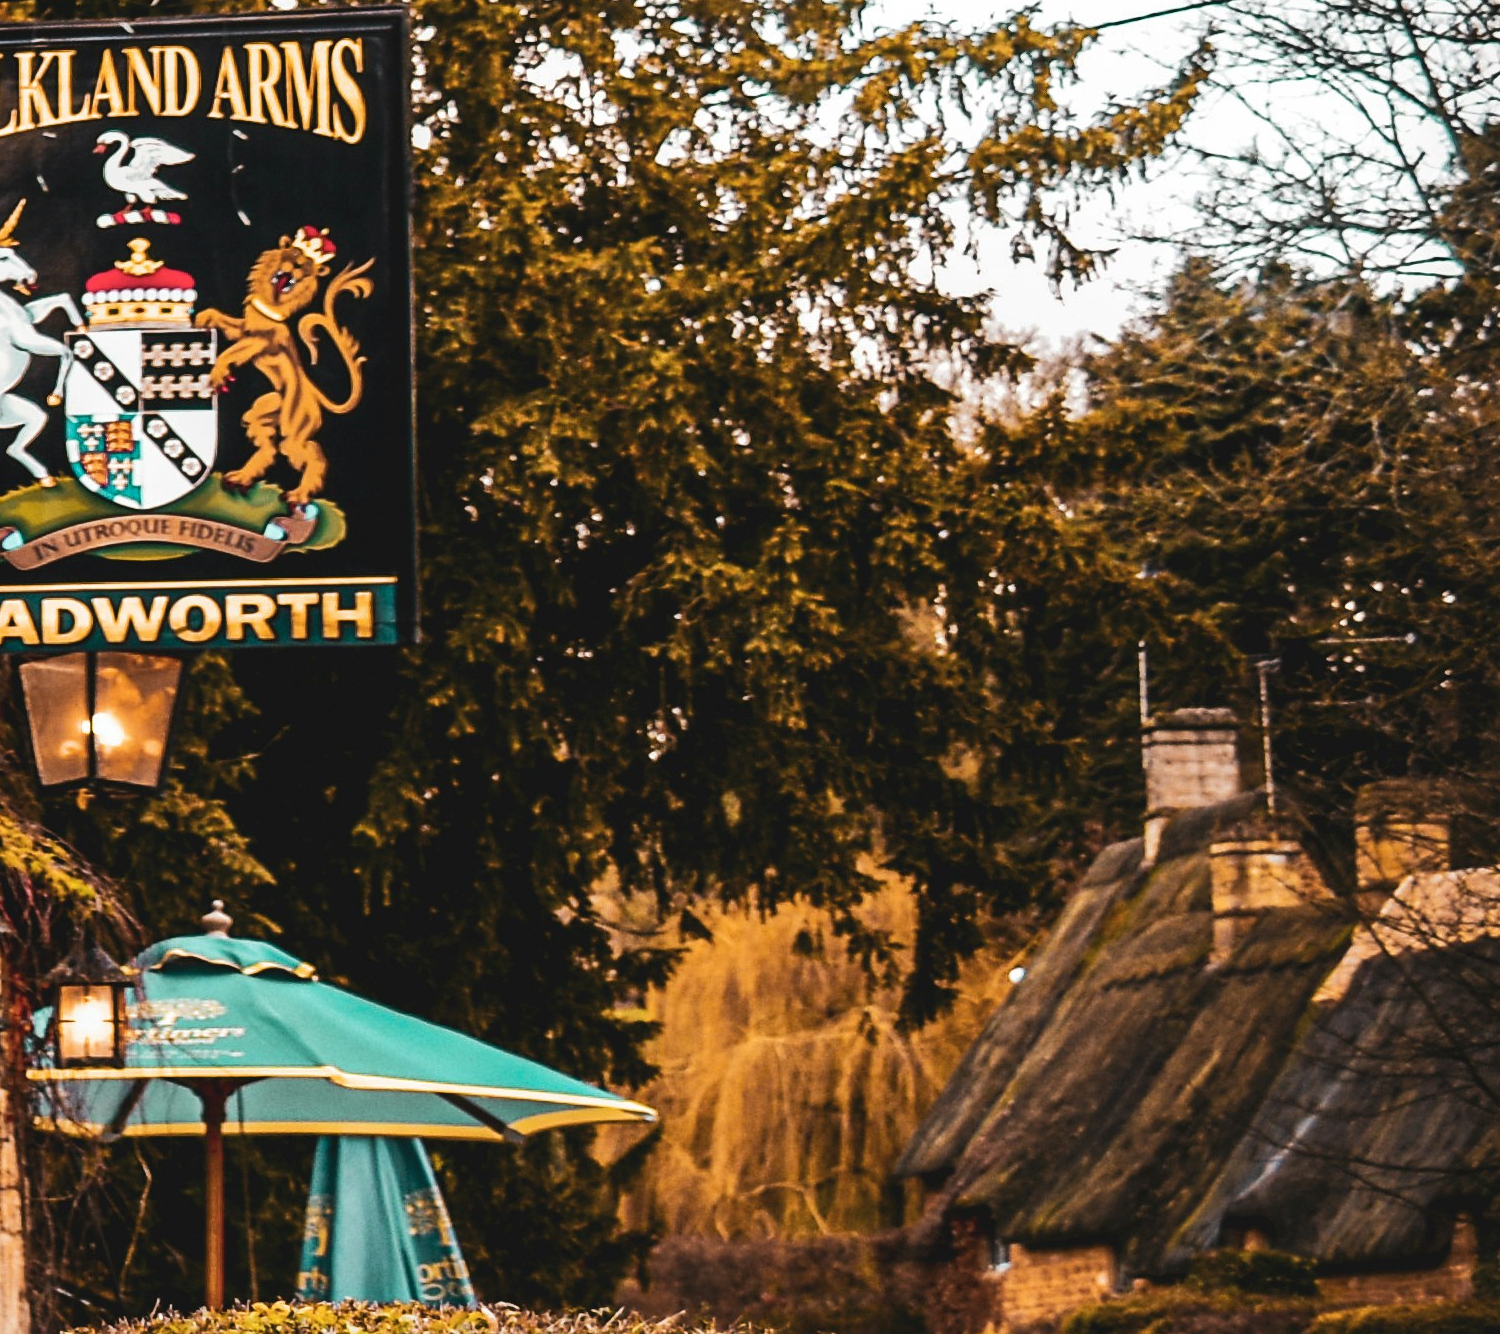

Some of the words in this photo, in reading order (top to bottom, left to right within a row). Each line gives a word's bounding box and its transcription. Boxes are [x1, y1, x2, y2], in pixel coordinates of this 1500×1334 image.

[207, 38, 367, 146] ARMS
[33, 540, 58, 560] IN
[63, 519, 174, 547] UTROQUE
[178, 520, 257, 553] FIDELIS
